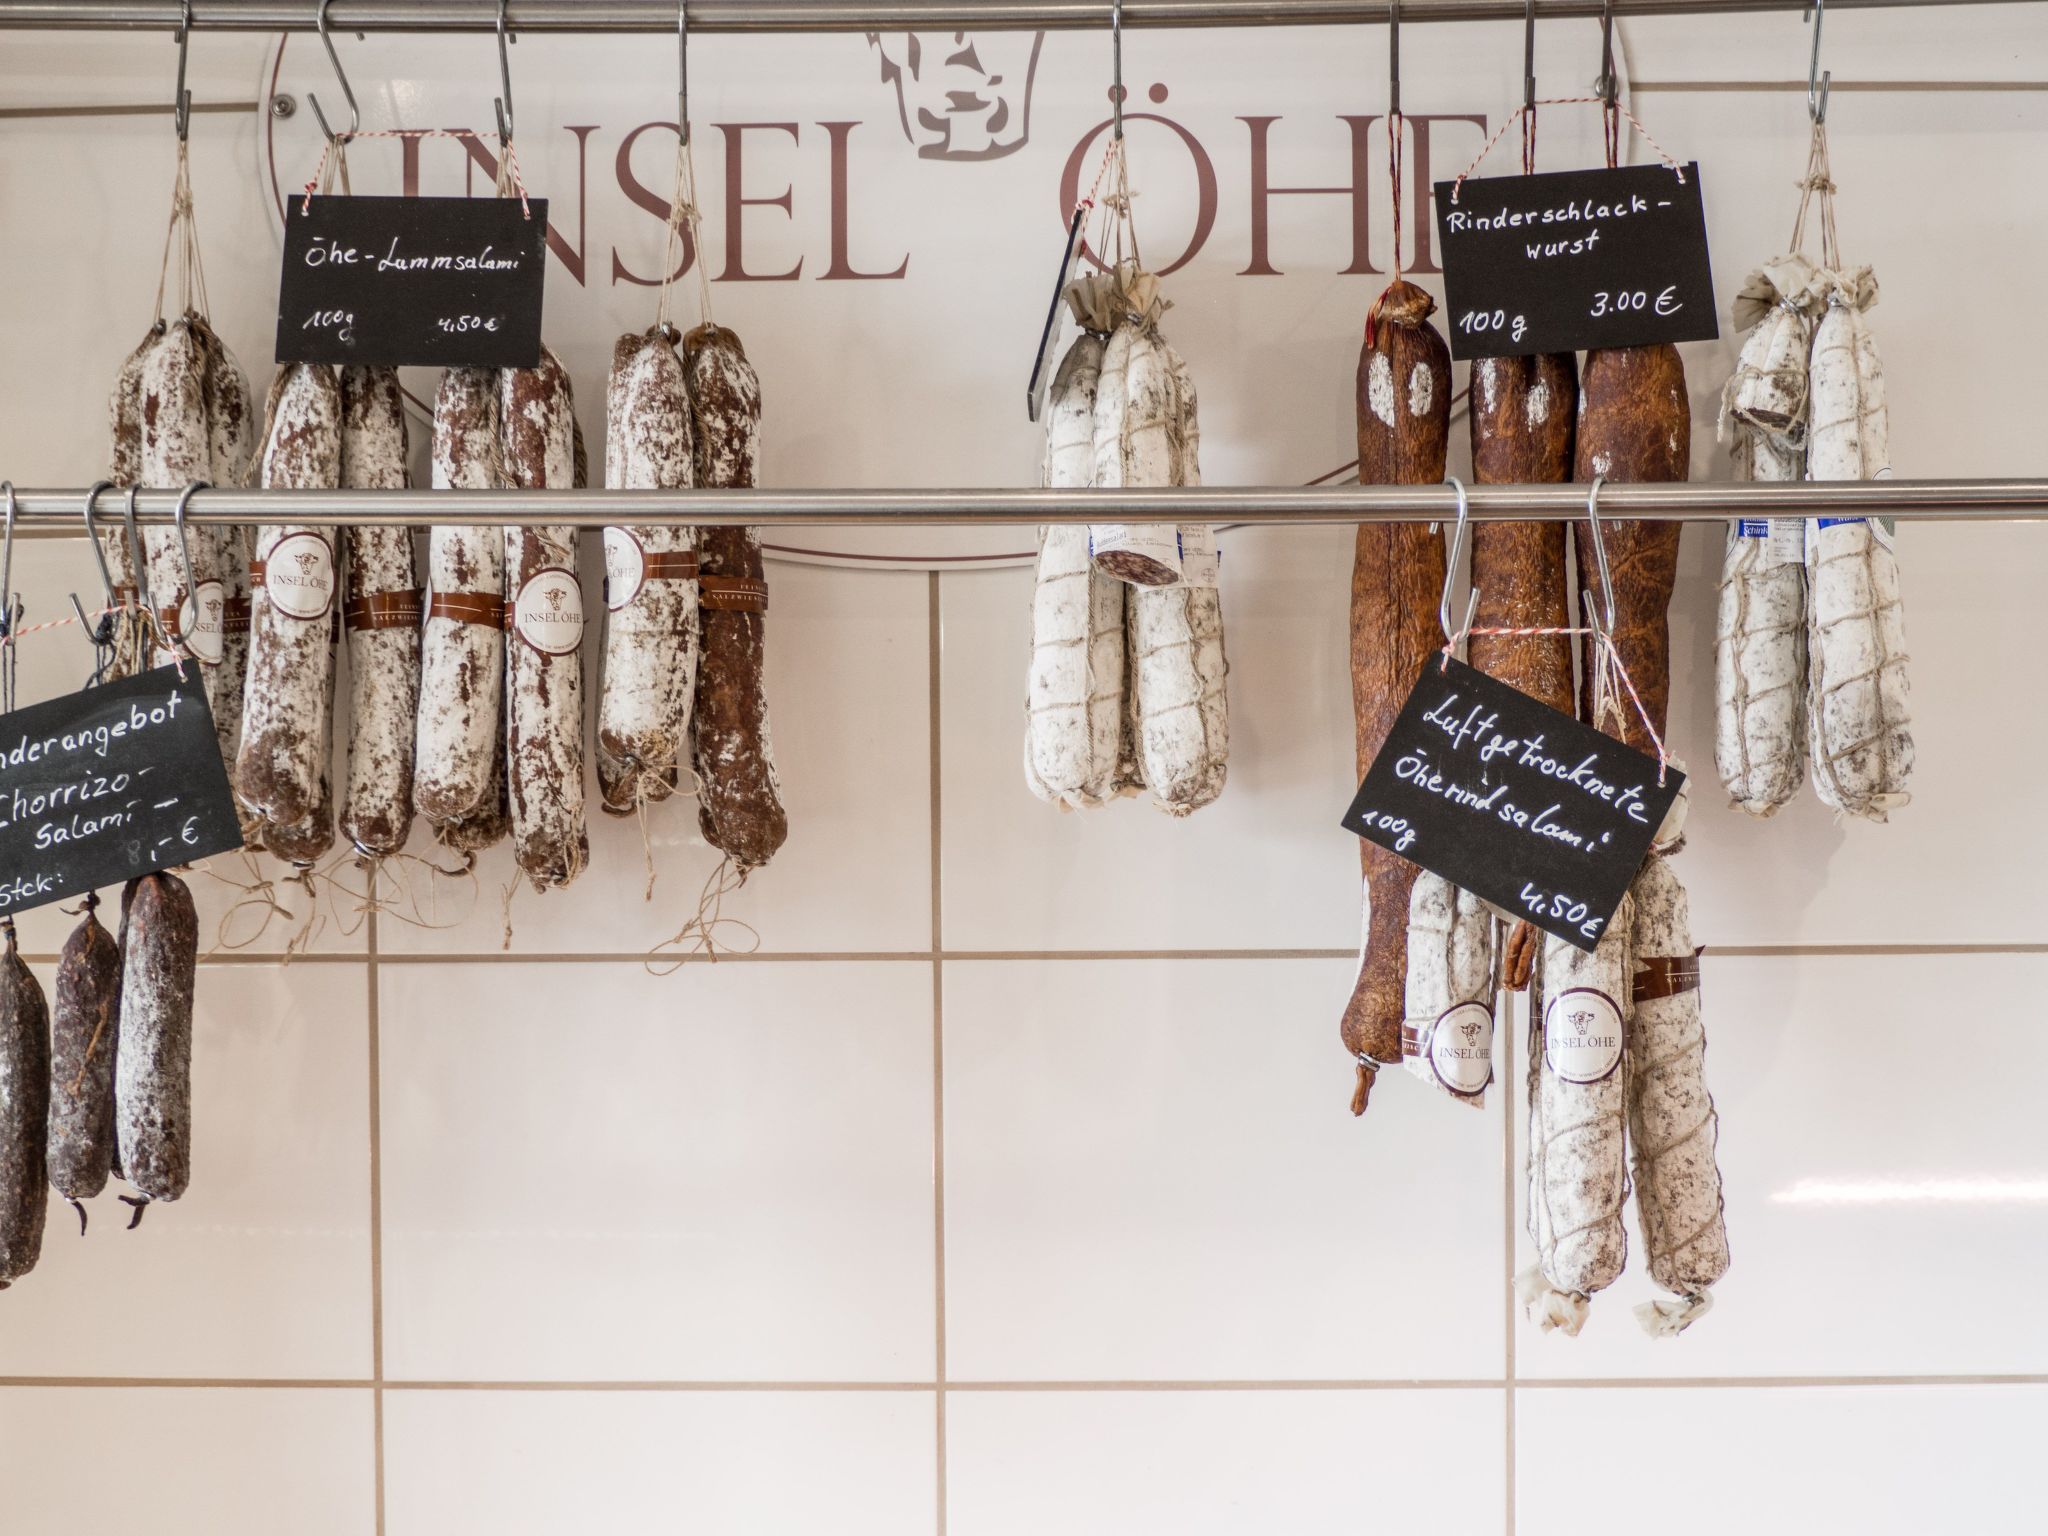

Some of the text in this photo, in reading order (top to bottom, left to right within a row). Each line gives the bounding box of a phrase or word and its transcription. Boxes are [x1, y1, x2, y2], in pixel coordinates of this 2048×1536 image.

[1060, 82, 1488, 280] ÖHE
[1526, 229, 1600, 260] wurst
[273, 574, 309, 587] INSEL
[524, 612, 560, 624] INSEL
[561, 611, 581, 624] ÖHE
[1551, 1033, 1616, 1049] INSEL ÖHE
[1440, 1046, 1490, 1060] INSEL ÖHE
